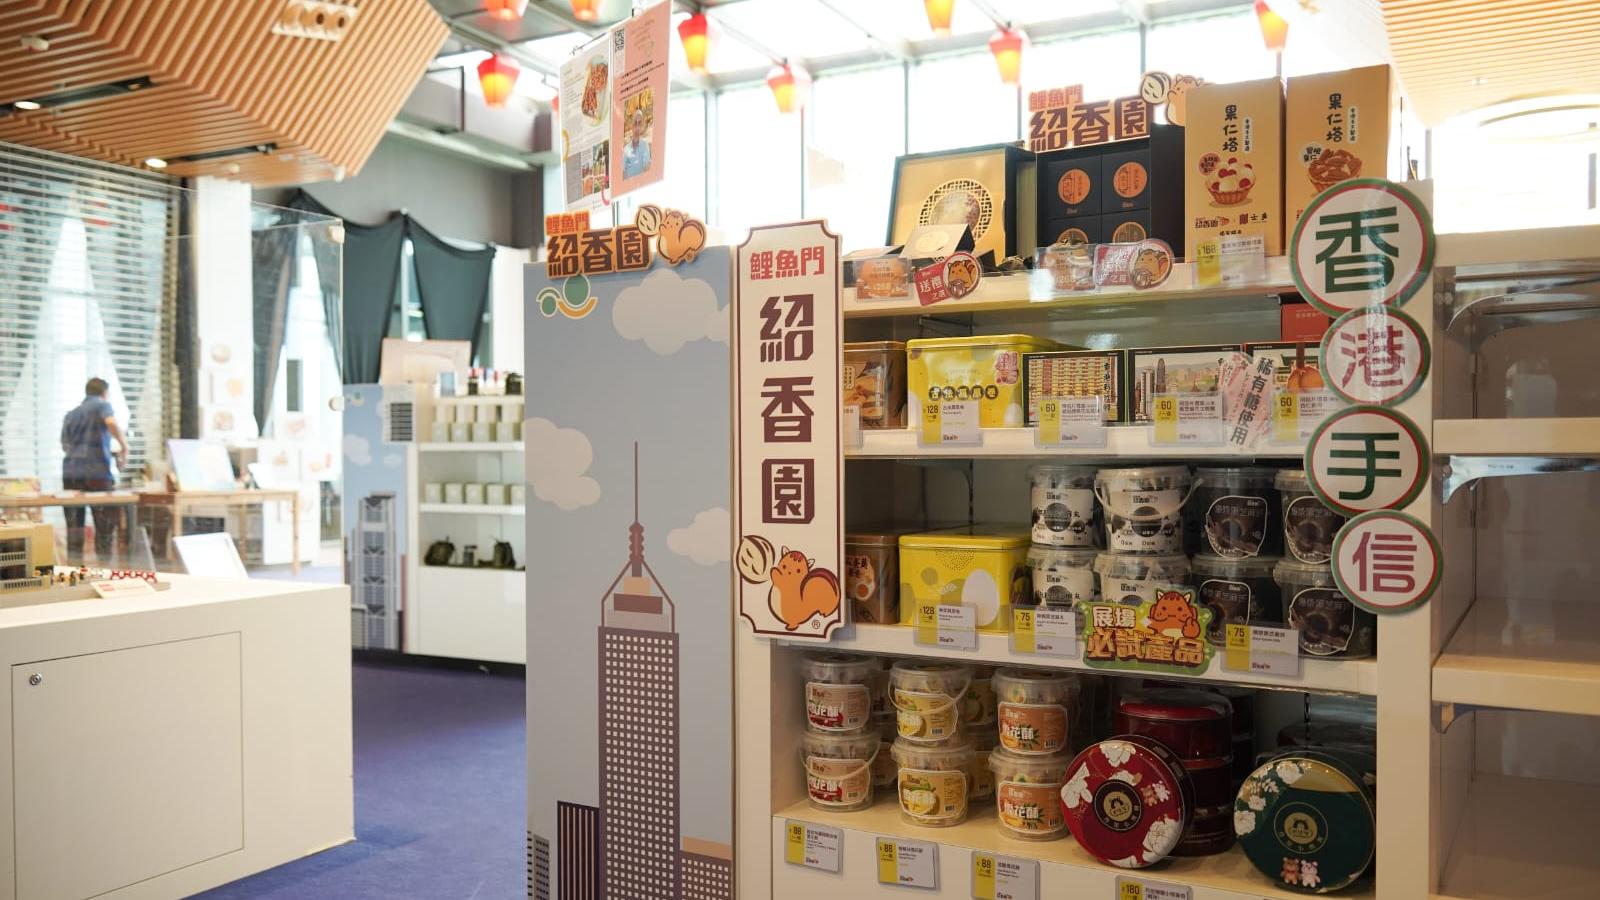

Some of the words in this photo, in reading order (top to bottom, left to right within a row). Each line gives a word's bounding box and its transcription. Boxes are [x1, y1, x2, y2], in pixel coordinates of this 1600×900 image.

[1029, 85, 1083, 110] 鯉魚門
[1030, 97, 1151, 151] 紹香園
[1222, 105, 1238, 152] 果仁塔
[1326, 93, 1344, 142] 果仁塔
[546, 211, 590, 234] 鯉魚門
[547, 227, 651, 278] 紹香園
[750, 246, 825, 280] 鯉魚門
[760, 294, 815, 524] 紹香園
[927, 404, 939, 414] 128
[1046, 403, 1056, 413] 60
[1161, 400, 1172, 410] 60
[1230, 356, 1275, 446] 稀有糖使用
[1280, 397, 1292, 407] 60
[1316, 206, 1418, 592] 香港手信
[922, 606, 935, 615] 128
[1020, 612, 1030, 621] 75
[1093, 606, 1137, 628] 展場
[1234, 628, 1245, 638] 75
[1087, 628, 1205, 666] 必試產品
[793, 826, 802, 836] 88
[884, 844, 893, 853] 88
[981, 859, 991, 869] 88
[1125, 884, 1140, 895] 180
